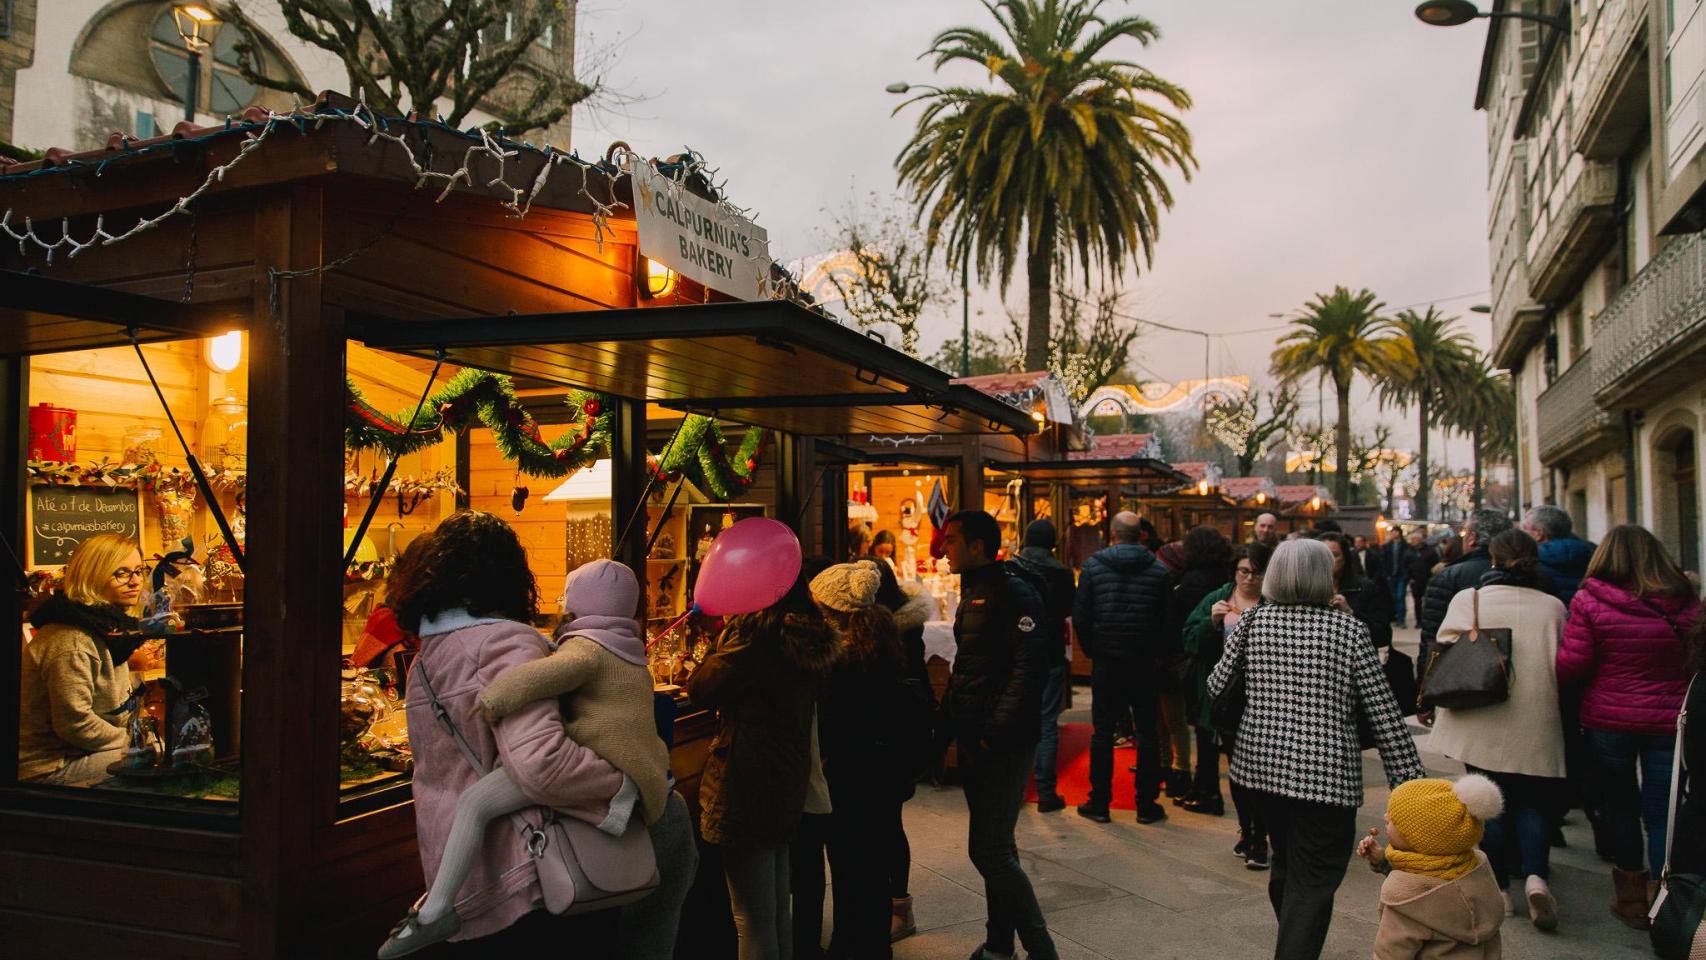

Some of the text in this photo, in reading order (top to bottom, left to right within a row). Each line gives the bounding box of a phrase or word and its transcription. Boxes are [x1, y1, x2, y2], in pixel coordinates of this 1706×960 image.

[655, 191, 750, 257] CALPURNIA'S
[679, 234, 733, 279] BAKERY
[37, 496, 57, 512] Até
[79, 499, 92, 512] de
